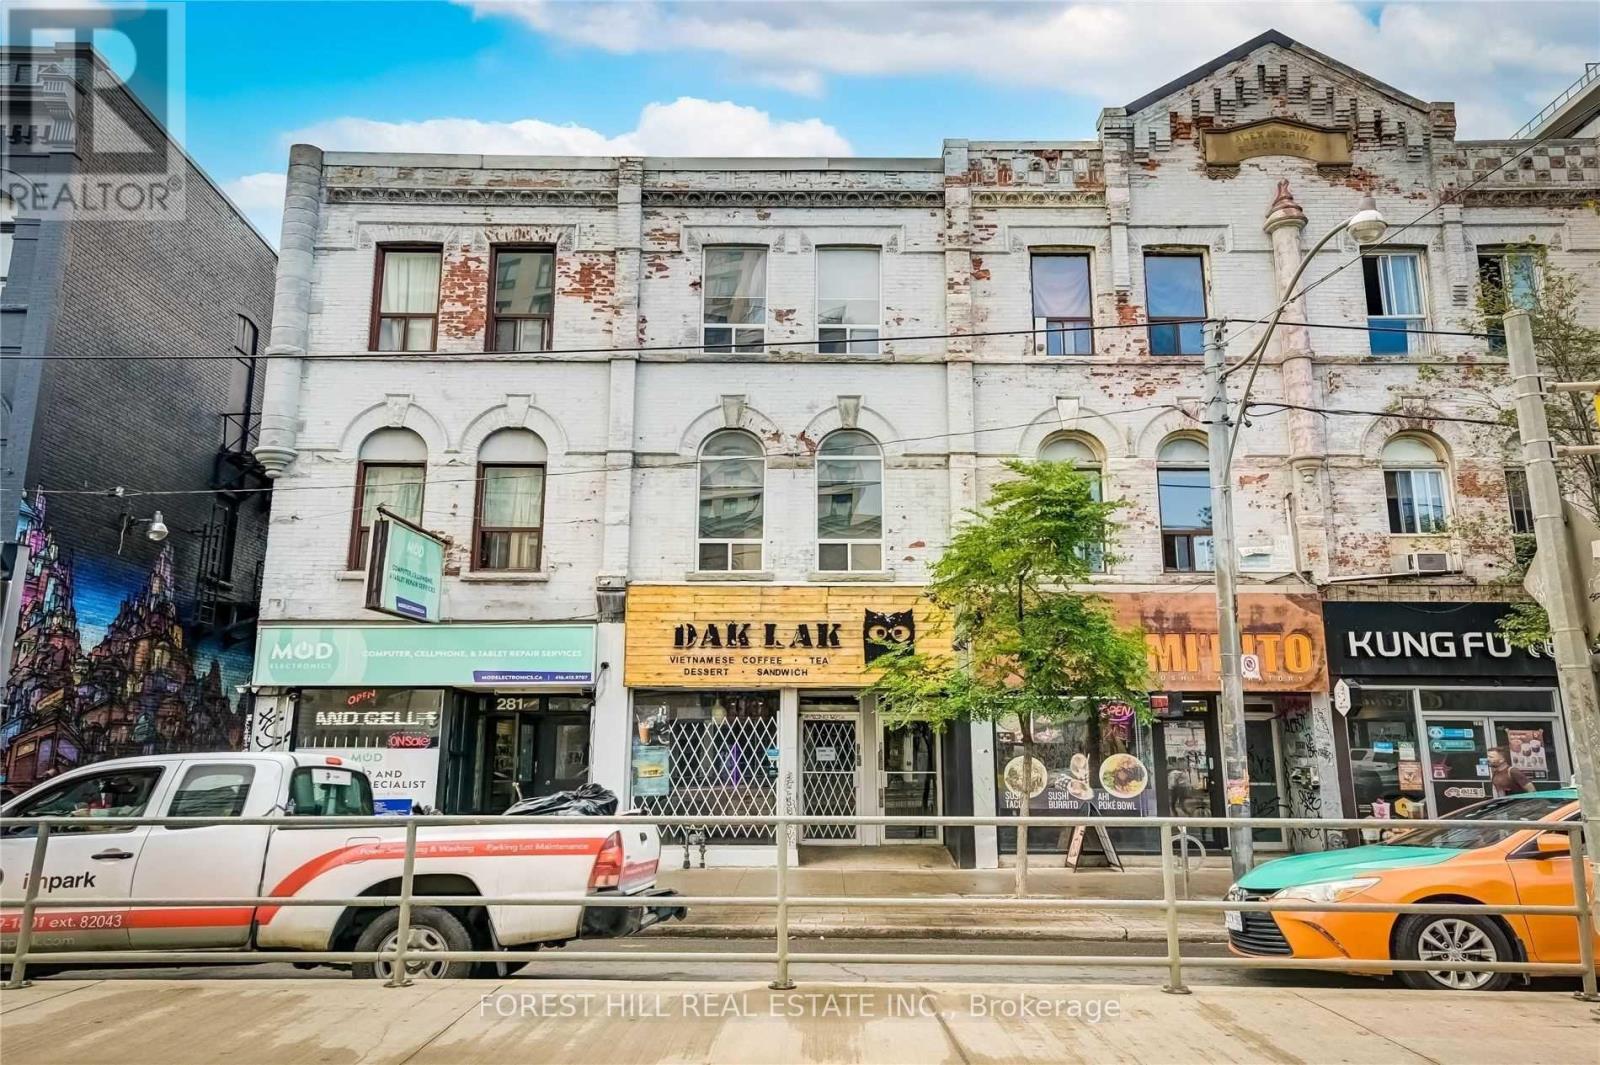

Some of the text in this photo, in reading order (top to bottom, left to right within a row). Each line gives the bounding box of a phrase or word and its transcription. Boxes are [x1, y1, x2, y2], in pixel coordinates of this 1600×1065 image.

[674, 623, 842, 649] DAK LAK
[1348, 631, 1457, 658] KUNG
[1463, 631, 1513, 658] FU
[271, 641, 333, 660] MOD
[362, 650, 413, 658] COMPUTER,
[669, 656, 829, 665] VIETNAMESE COFFEE TEA
[270, 662, 332, 670] ELECTRONICS
[683, 667, 808, 676] DESSERT SANDWICH
[347, 689, 376, 705] OPEN
[496, 697, 524, 711] 281
[375, 770, 403, 779] AND
[373, 780, 427, 789] ECIALIST
[1047, 791, 1070, 800] SUSHI
[1097, 792, 1110, 801] AHI
[1048, 800, 1079, 809] BURRITO
[1116, 801, 1137, 810] BOWL
[535, 841, 590, 851] Maintenance
[49, 917, 76, 928] ext.
[79, 914, 122, 928] 82043
